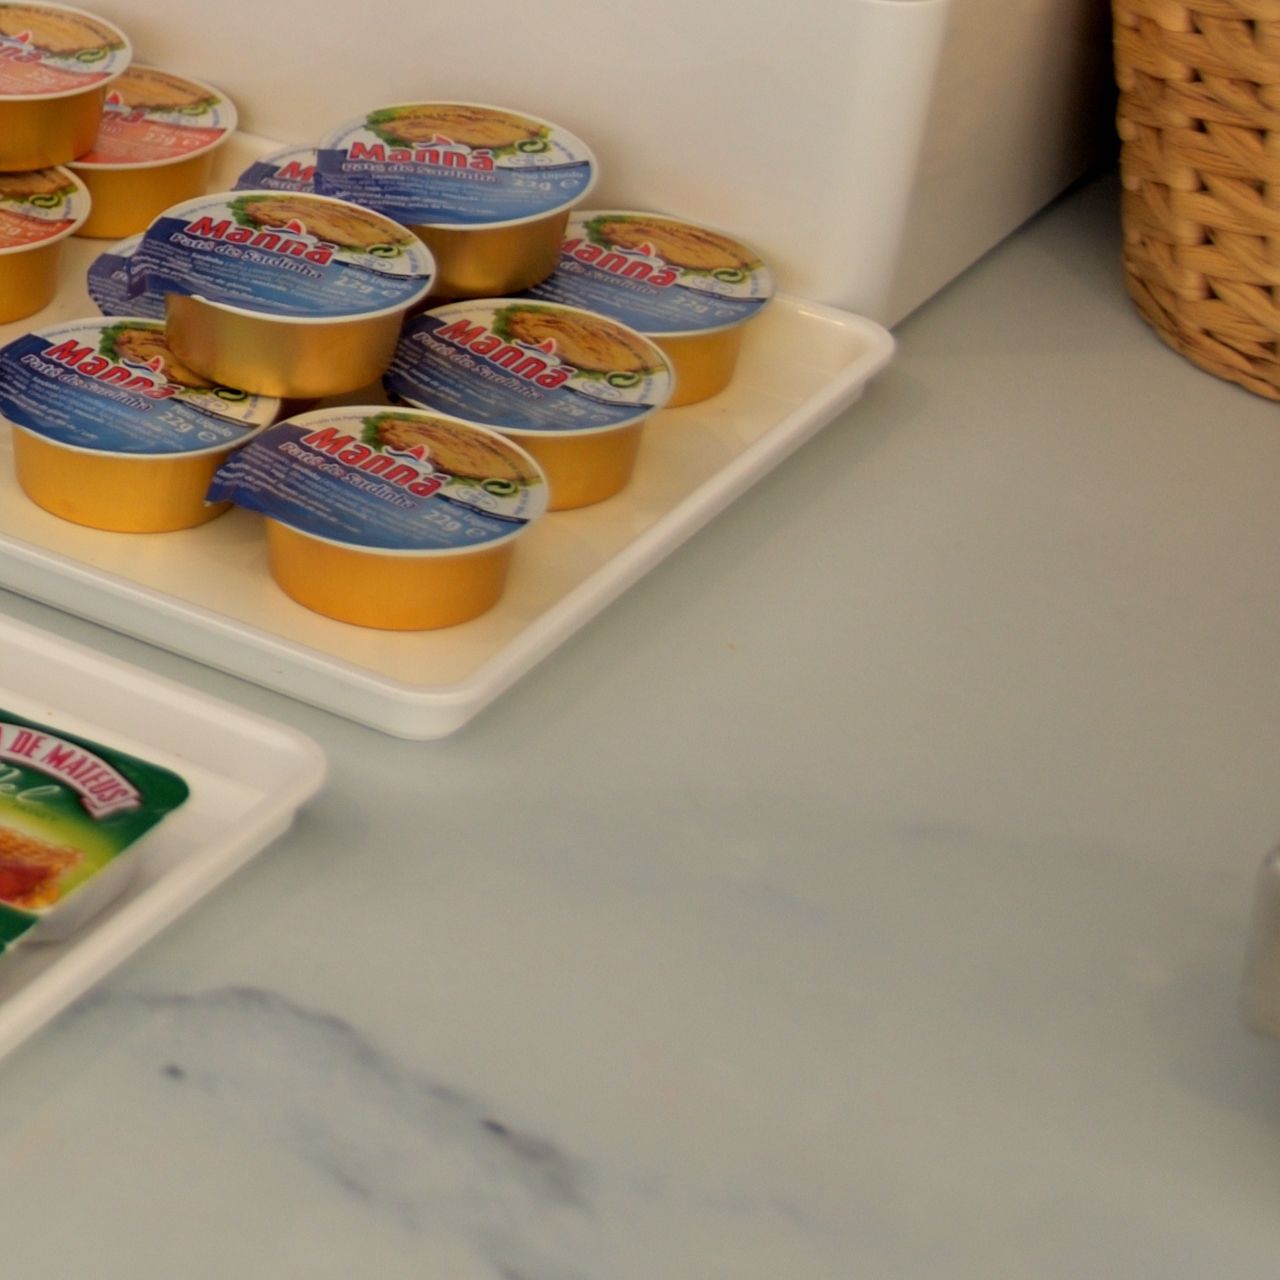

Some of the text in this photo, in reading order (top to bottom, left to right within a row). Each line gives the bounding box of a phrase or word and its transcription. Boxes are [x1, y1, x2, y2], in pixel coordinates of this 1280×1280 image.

[512, 179, 552, 192] 22g
[159, 411, 195, 433] 22g
[424, 511, 461, 533] 22g
[8, 730, 48, 757] DE
[41, 743, 129, 803] MATEUS
